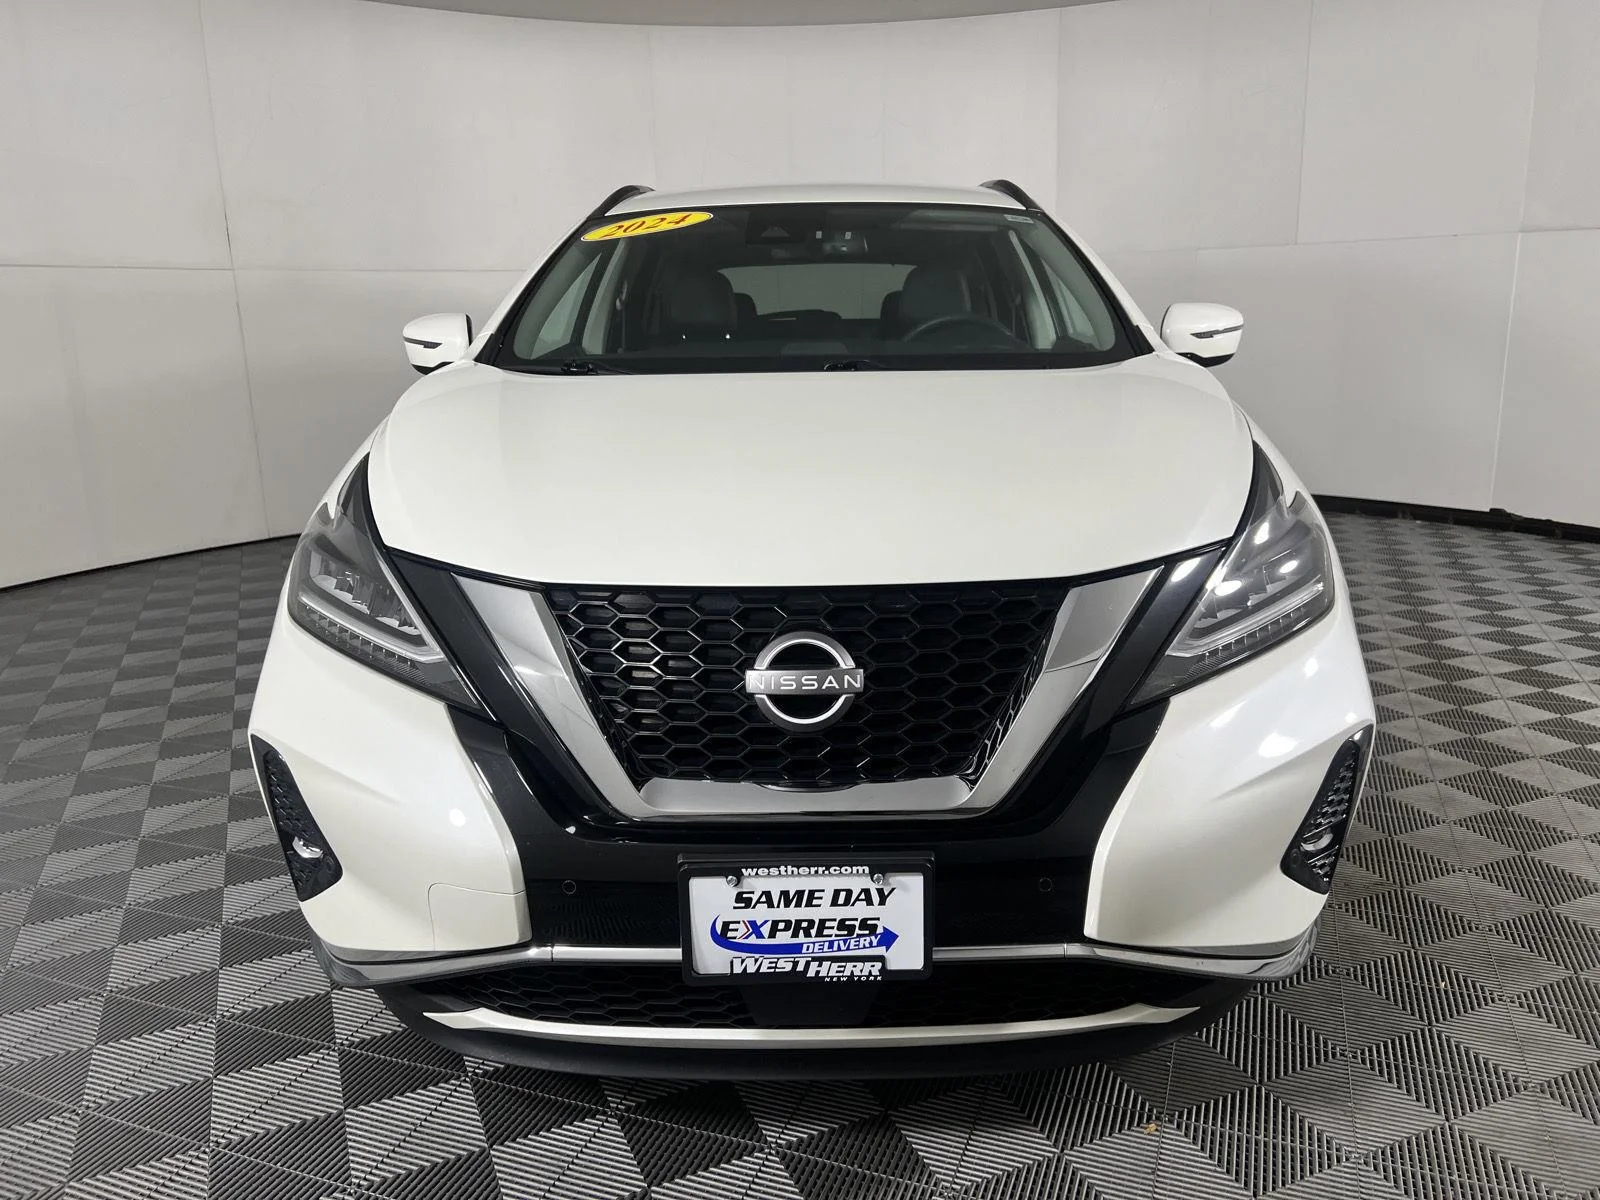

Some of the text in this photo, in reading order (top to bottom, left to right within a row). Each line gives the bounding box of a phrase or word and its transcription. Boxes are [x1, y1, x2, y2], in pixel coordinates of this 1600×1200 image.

[598, 213, 693, 239] 2024
[748, 674, 861, 690] NISSAN
[741, 865, 870, 876] westherr.com
[733, 887, 896, 909] SAME DAY
[719, 917, 880, 940] EXPRESS
[801, 934, 881, 954] DELIVERY
